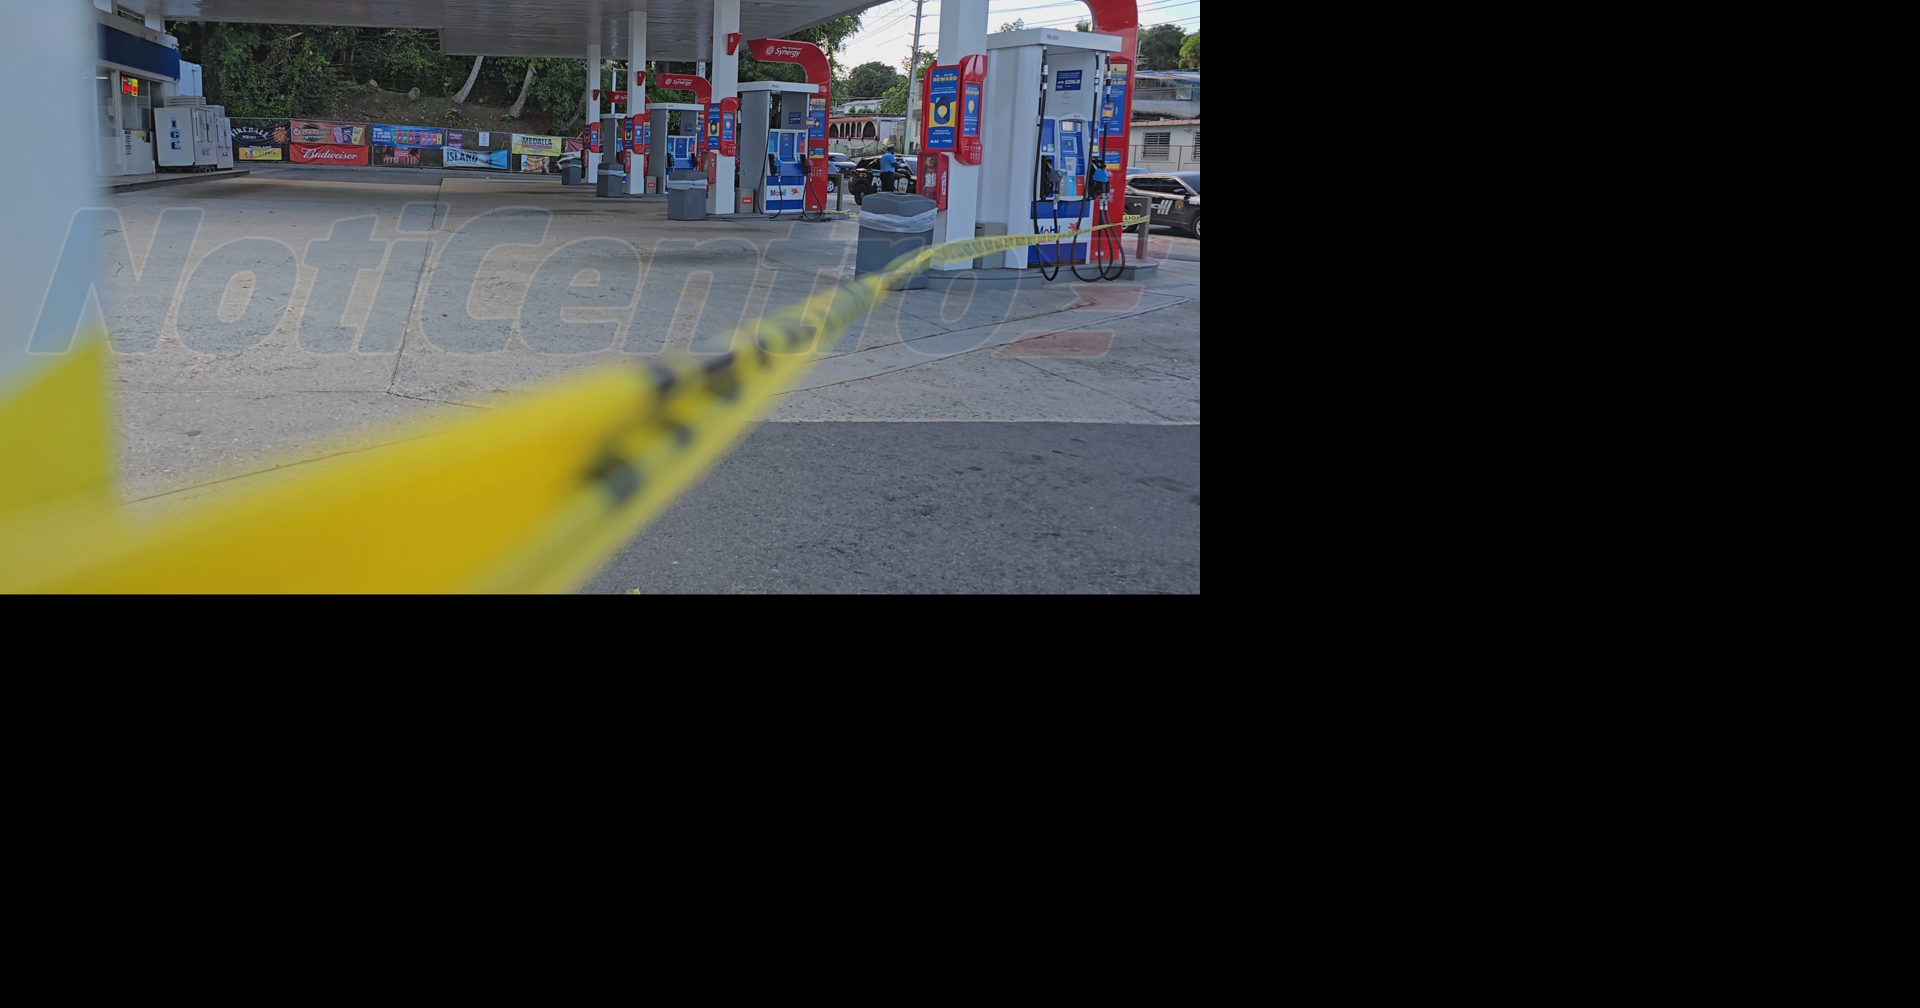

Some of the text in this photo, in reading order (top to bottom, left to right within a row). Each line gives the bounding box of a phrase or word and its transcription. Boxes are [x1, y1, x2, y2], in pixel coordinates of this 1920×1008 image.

[775, 48, 800, 57] Synergy
[231, 127, 269, 140] FIREBALL
[522, 137, 552, 146] MEDALLA
[301, 148, 358, 160] Budweiser
[446, 151, 479, 163] ISLAND
